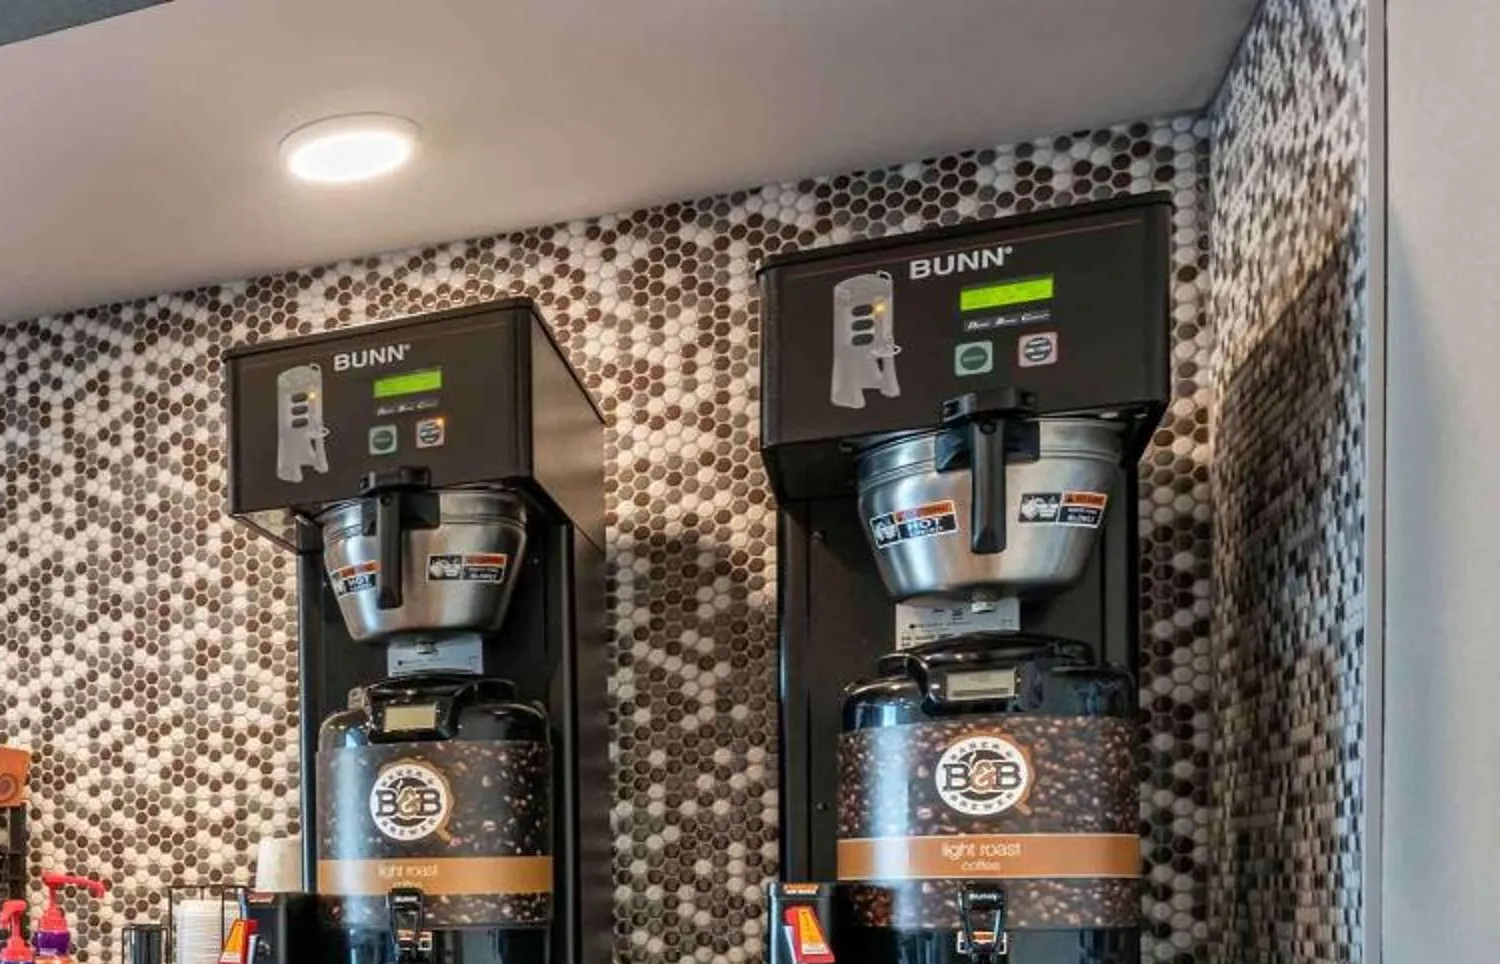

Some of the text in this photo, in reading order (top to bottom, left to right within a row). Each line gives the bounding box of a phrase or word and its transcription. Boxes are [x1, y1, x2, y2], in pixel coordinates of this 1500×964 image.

[908, 247, 1005, 281] BUNN
[333, 347, 405, 372] BUNN
[942, 841, 1021, 861] light roast
